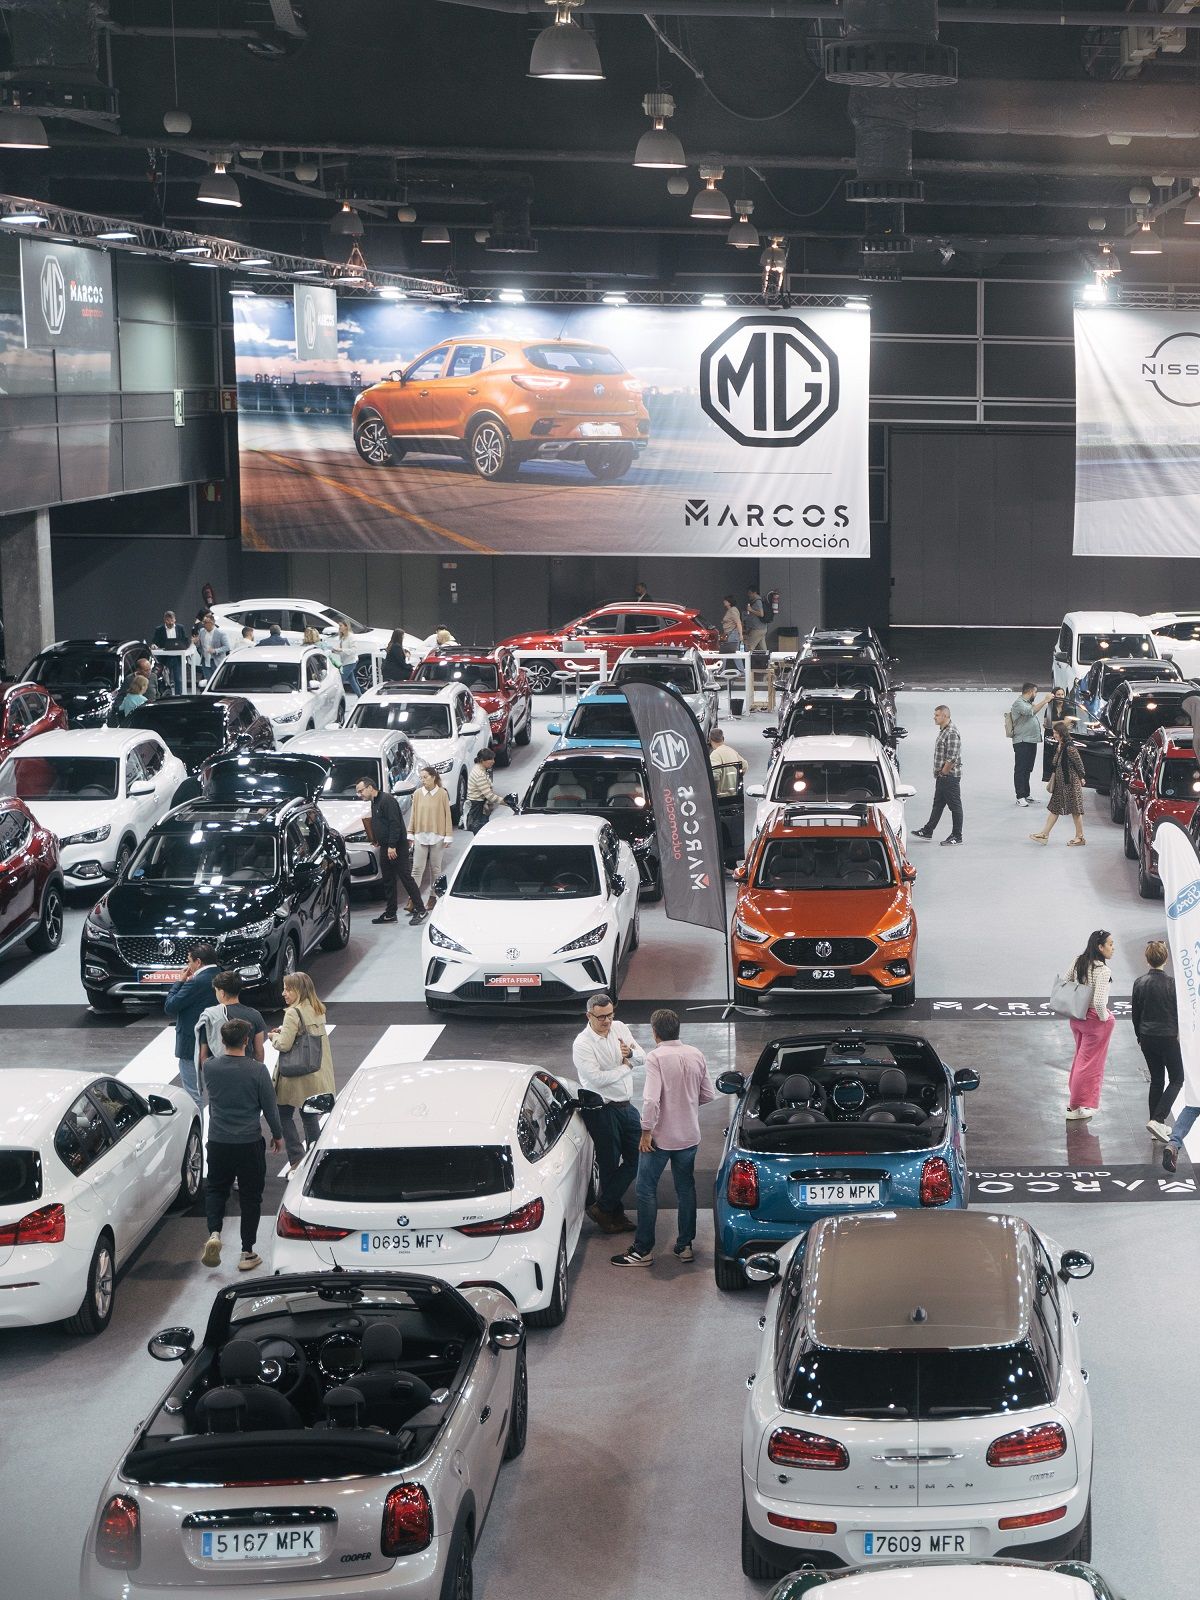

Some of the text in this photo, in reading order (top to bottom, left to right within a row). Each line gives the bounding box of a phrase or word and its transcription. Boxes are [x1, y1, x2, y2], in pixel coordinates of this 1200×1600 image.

[42, 262, 64, 328] MG
[69, 281, 104, 304] MARCOS
[716, 332, 823, 432] MG
[684, 499, 850, 528] MARCOS
[737, 533, 850, 549] automoción
[822, 970, 836, 978] ZS
[809, 1185, 875, 1200] 5178 MPK
[977, 1178, 1197, 1194] MARCO
[372, 1234, 444, 1250] 0695 MFY
[217, 1530, 315, 1553] 5167 MPK
[876, 1535, 965, 1553] 7609 MFR
[340, 1551, 372, 1563] COOPER
